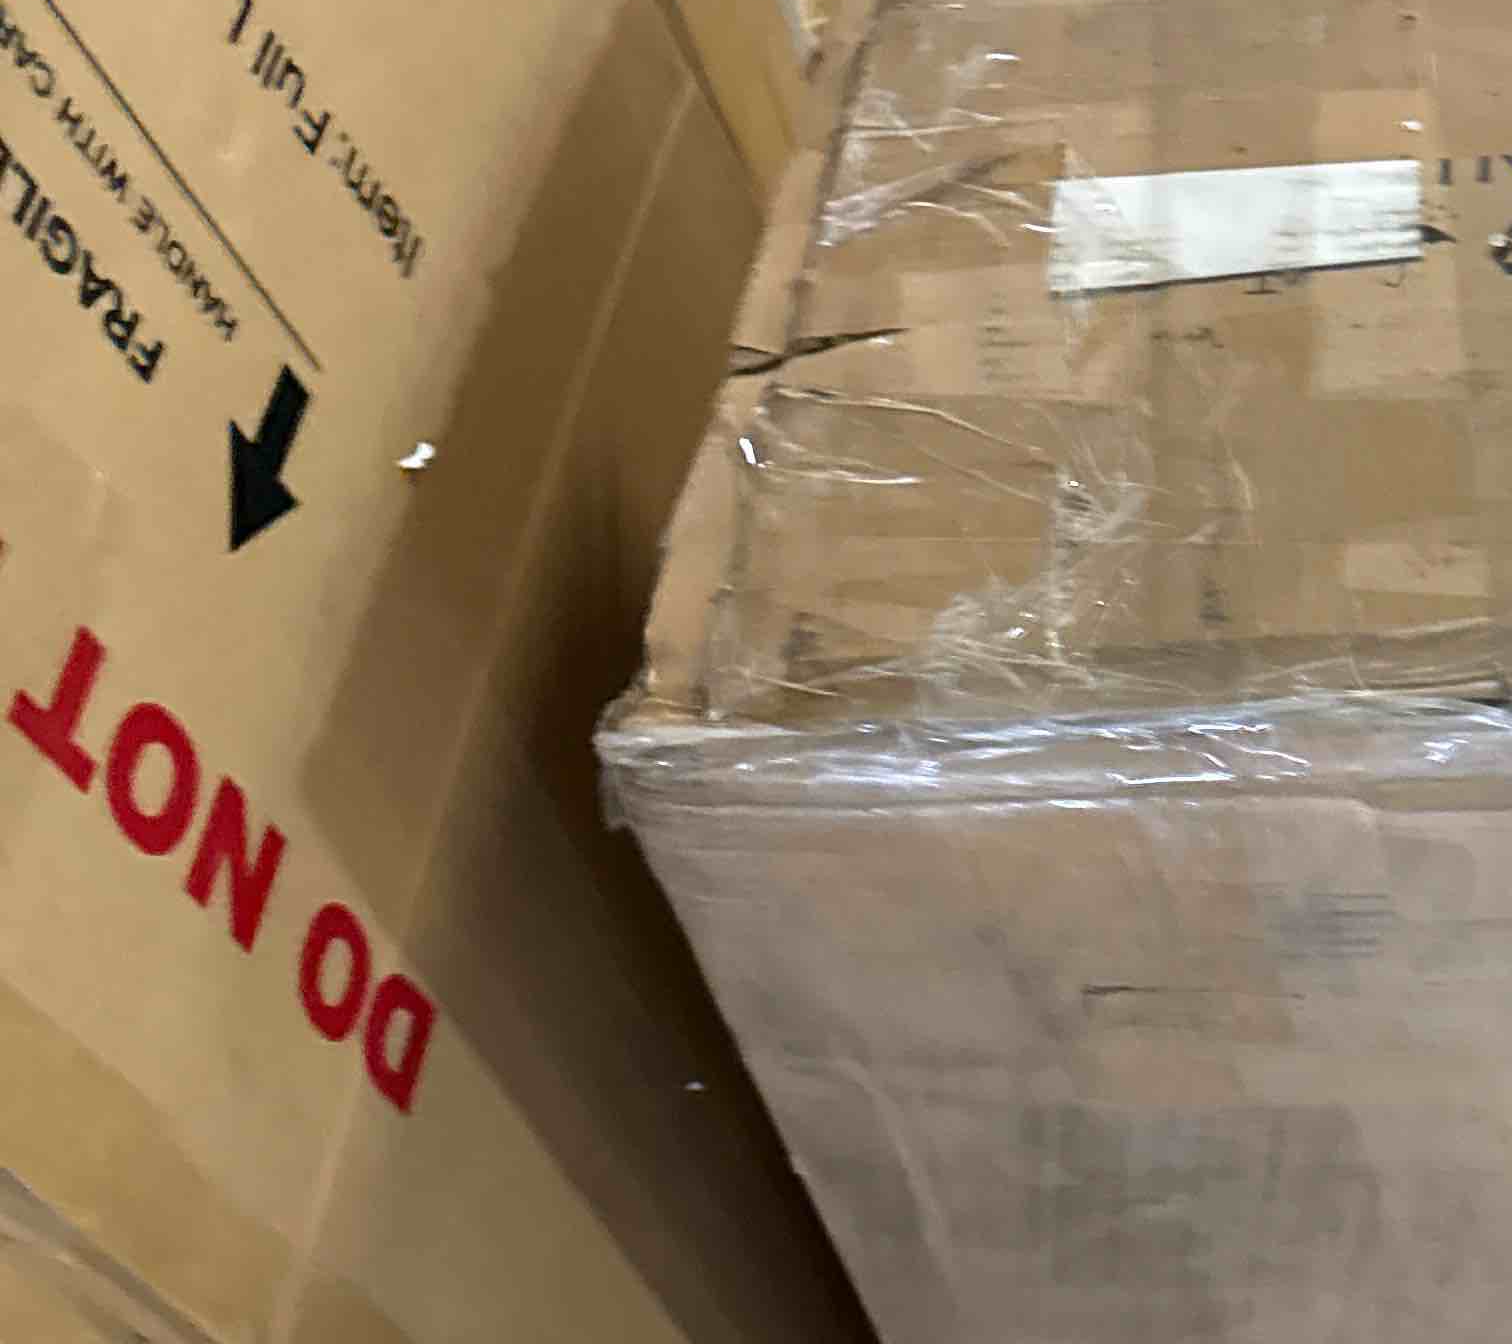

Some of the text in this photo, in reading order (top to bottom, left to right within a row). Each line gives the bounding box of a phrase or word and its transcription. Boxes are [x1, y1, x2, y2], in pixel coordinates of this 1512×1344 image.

[0, 2, 238, 342] HANDLE WITH CAR
[250, 29, 332, 156] Full
[329, 130, 424, 280] Item:
[5, 624, 437, 1115] DO NOT
